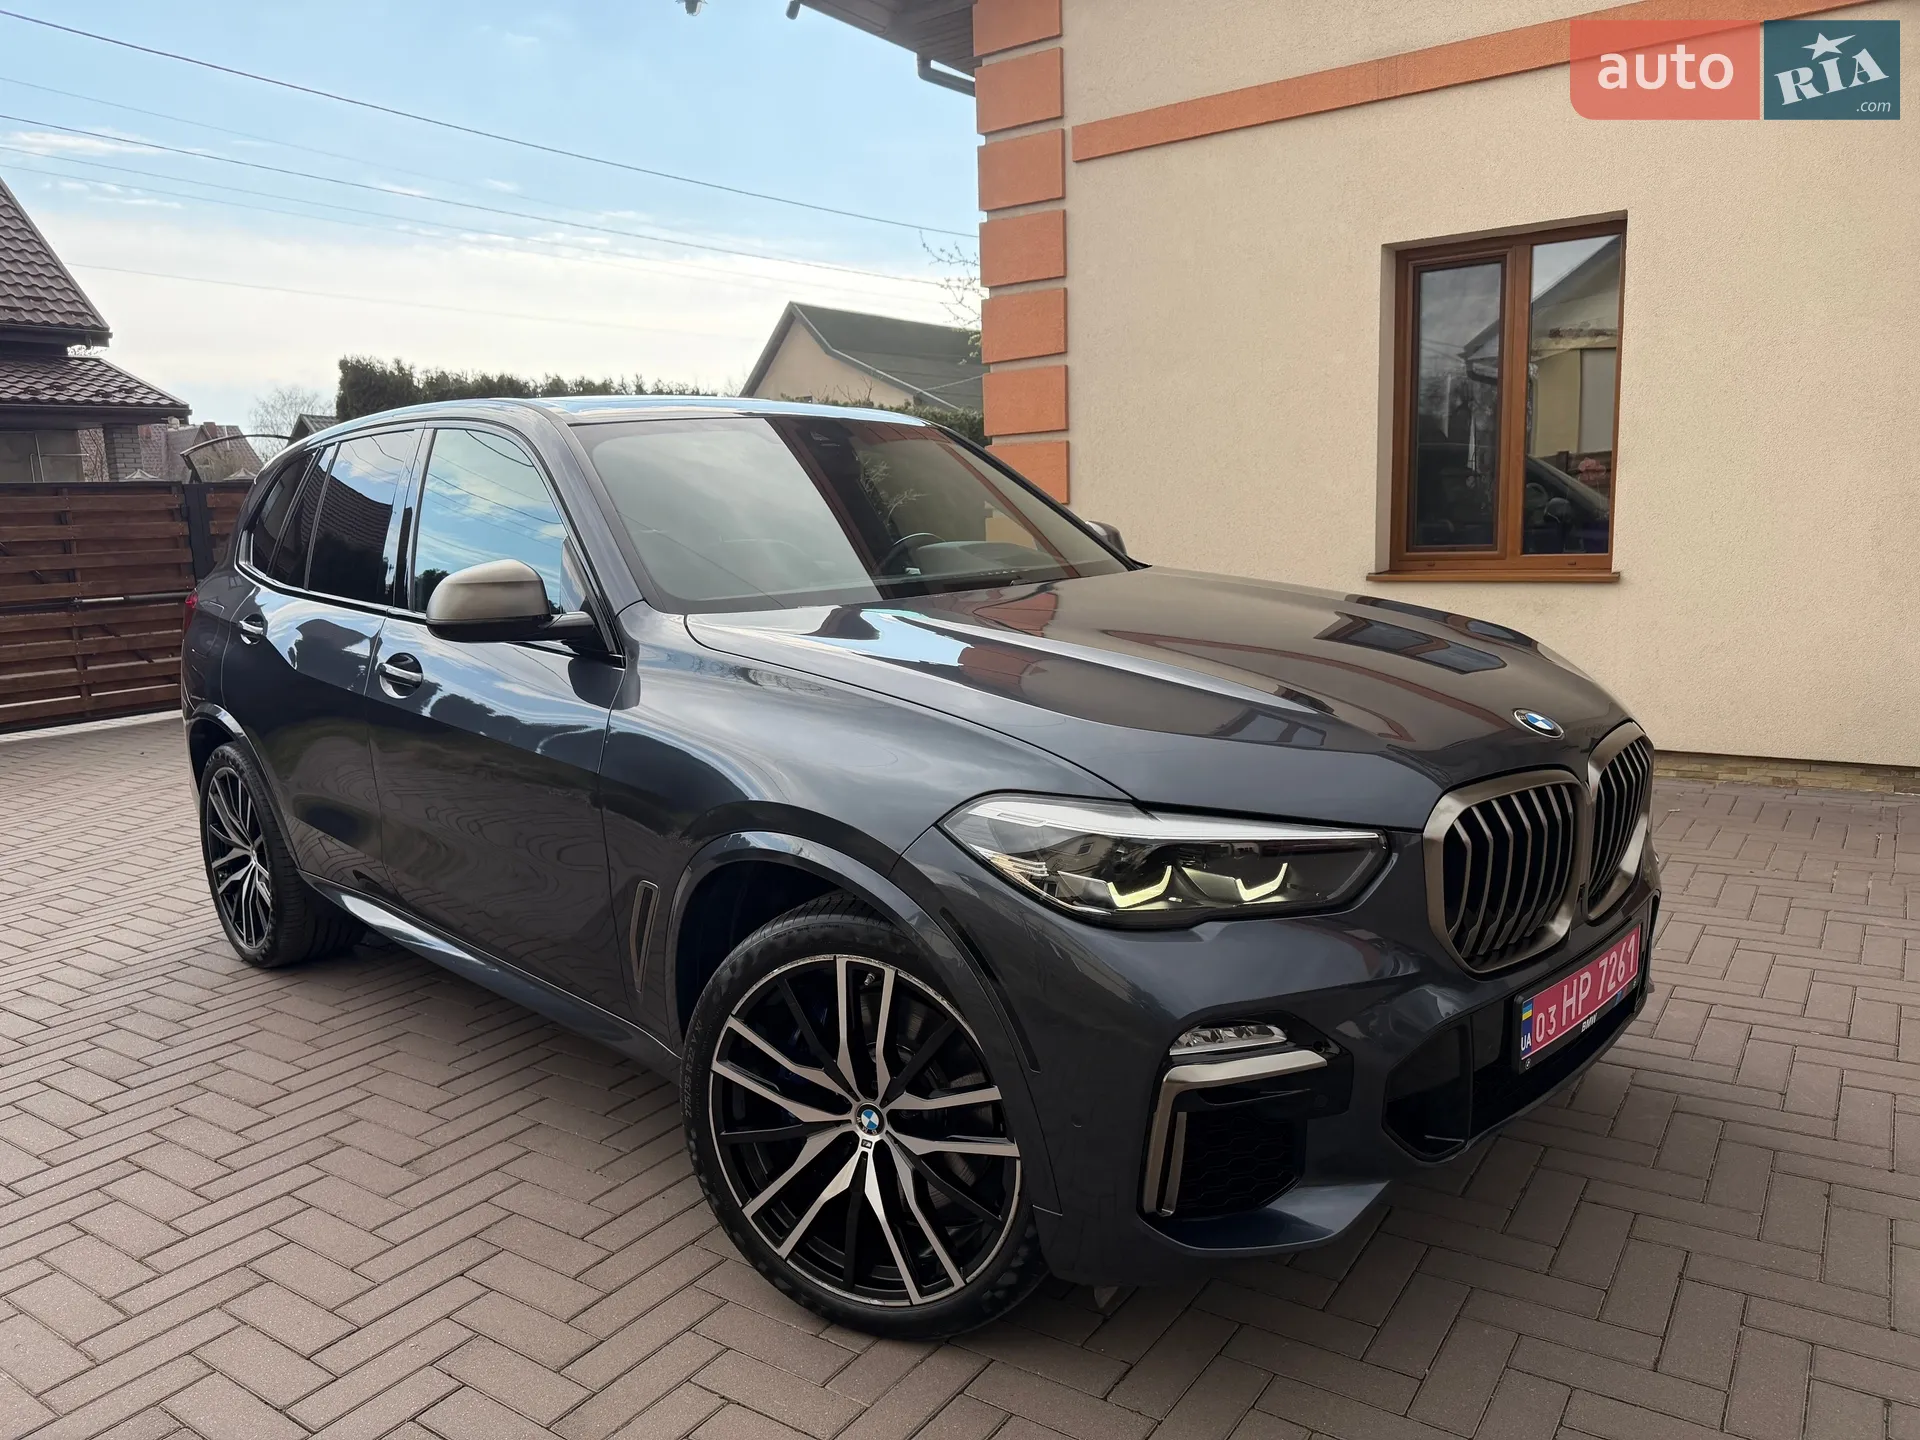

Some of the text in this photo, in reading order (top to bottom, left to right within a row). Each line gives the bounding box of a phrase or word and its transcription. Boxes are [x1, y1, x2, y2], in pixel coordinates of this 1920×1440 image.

[1535, 934, 1636, 1043] 03 HP 7261
[1581, 1012, 1598, 1033] BMW
[1520, 1032, 1532, 1051] UA
